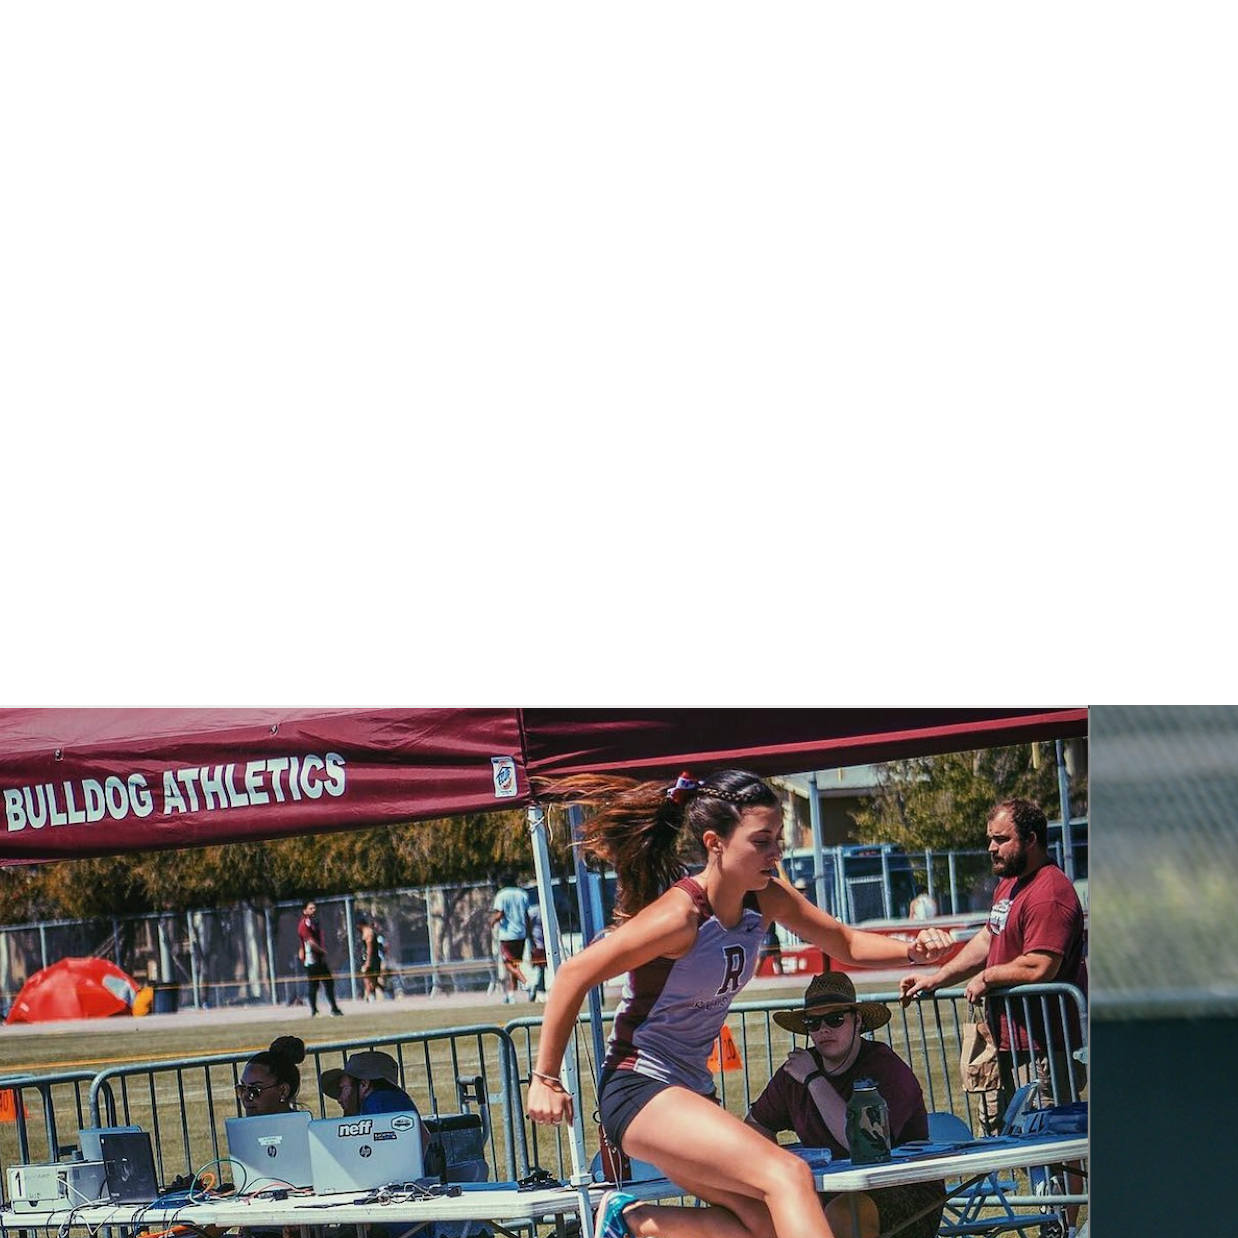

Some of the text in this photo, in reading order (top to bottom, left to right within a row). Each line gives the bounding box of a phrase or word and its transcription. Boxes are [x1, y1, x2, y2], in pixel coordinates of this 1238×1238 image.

[3, 752, 346, 832] BULLDOG ATHLETICS
[715, 943, 747, 997] R
[338, 1119, 373, 1137] neff
